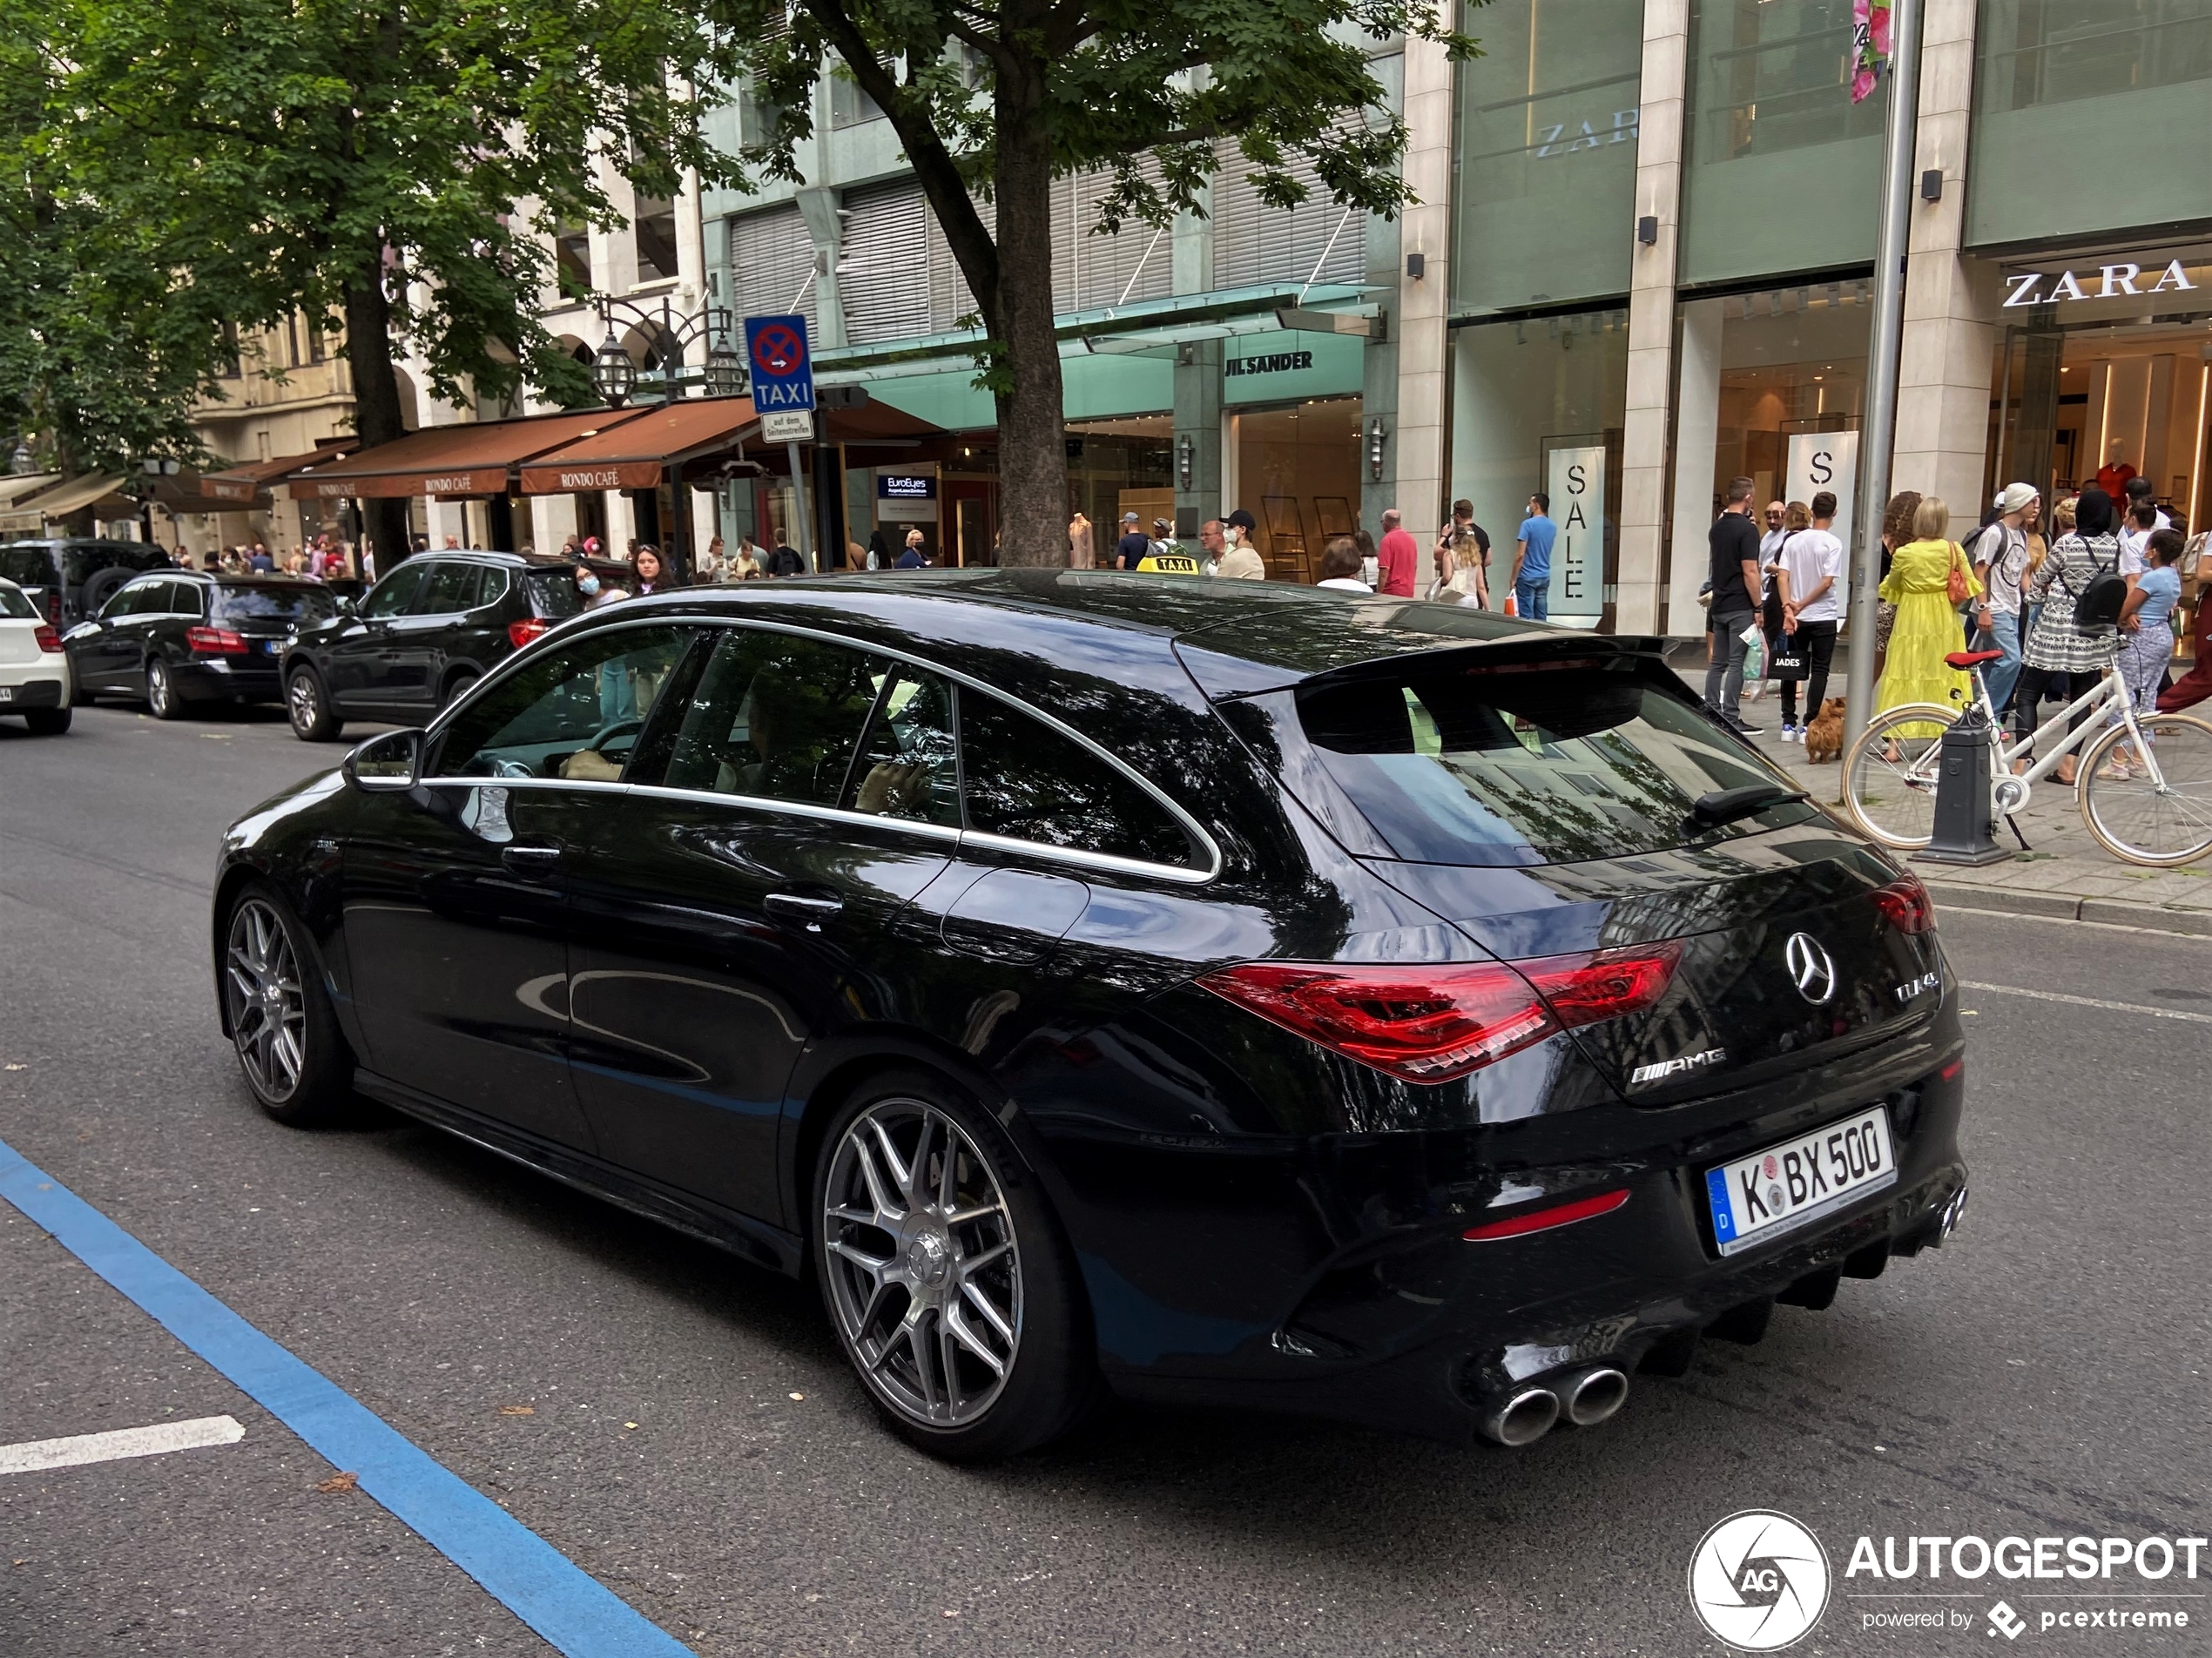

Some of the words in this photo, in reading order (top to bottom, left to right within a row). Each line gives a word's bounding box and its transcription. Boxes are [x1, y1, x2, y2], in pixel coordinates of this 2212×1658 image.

[2002, 259, 2200, 307] ZARA
[1224, 358, 1245, 377] JIL
[1246, 351, 1313, 374] SANDER
[757, 383, 809, 405] TAXI
[766, 424, 810, 436] Seitenstreifen
[773, 417, 784, 426] auf
[786, 416, 799, 425] dem
[425, 478, 452, 493] RONDO
[453, 473, 471, 490] CAFÉ
[562, 472, 594, 488] RONDO
[595, 467, 619, 486] CAFÉ
[887, 477, 926, 489] EuroEyes
[1565, 464, 1587, 598] SALE
[1159, 558, 1190, 570] TAXI
[1775, 657, 1800, 667] JADES
[1741, 1163, 1770, 1224] K
[1783, 1142, 1828, 1206] BX
[1827, 1120, 1881, 1187] 500
[1718, 1213, 1729, 1230] D
